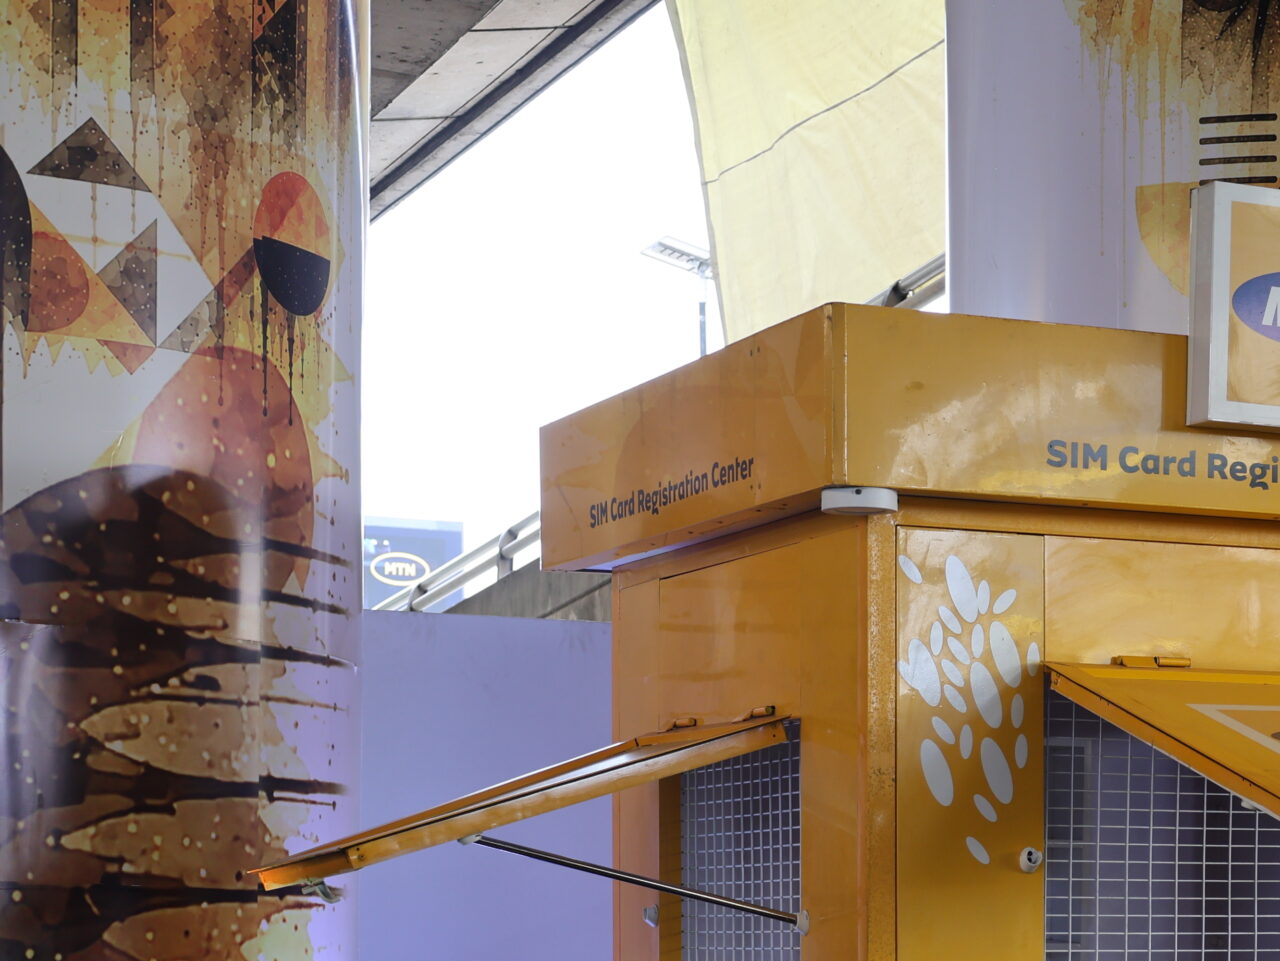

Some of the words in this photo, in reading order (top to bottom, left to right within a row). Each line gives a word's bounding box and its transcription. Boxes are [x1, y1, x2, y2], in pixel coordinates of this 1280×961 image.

[1046, 439, 1108, 471] SIM
[1118, 446, 1197, 477] Card
[589, 501, 608, 529] SIM
[610, 491, 635, 522] Card
[637, 469, 708, 515] Registration
[711, 456, 754, 489] Center
[384, 561, 417, 577] MTN
